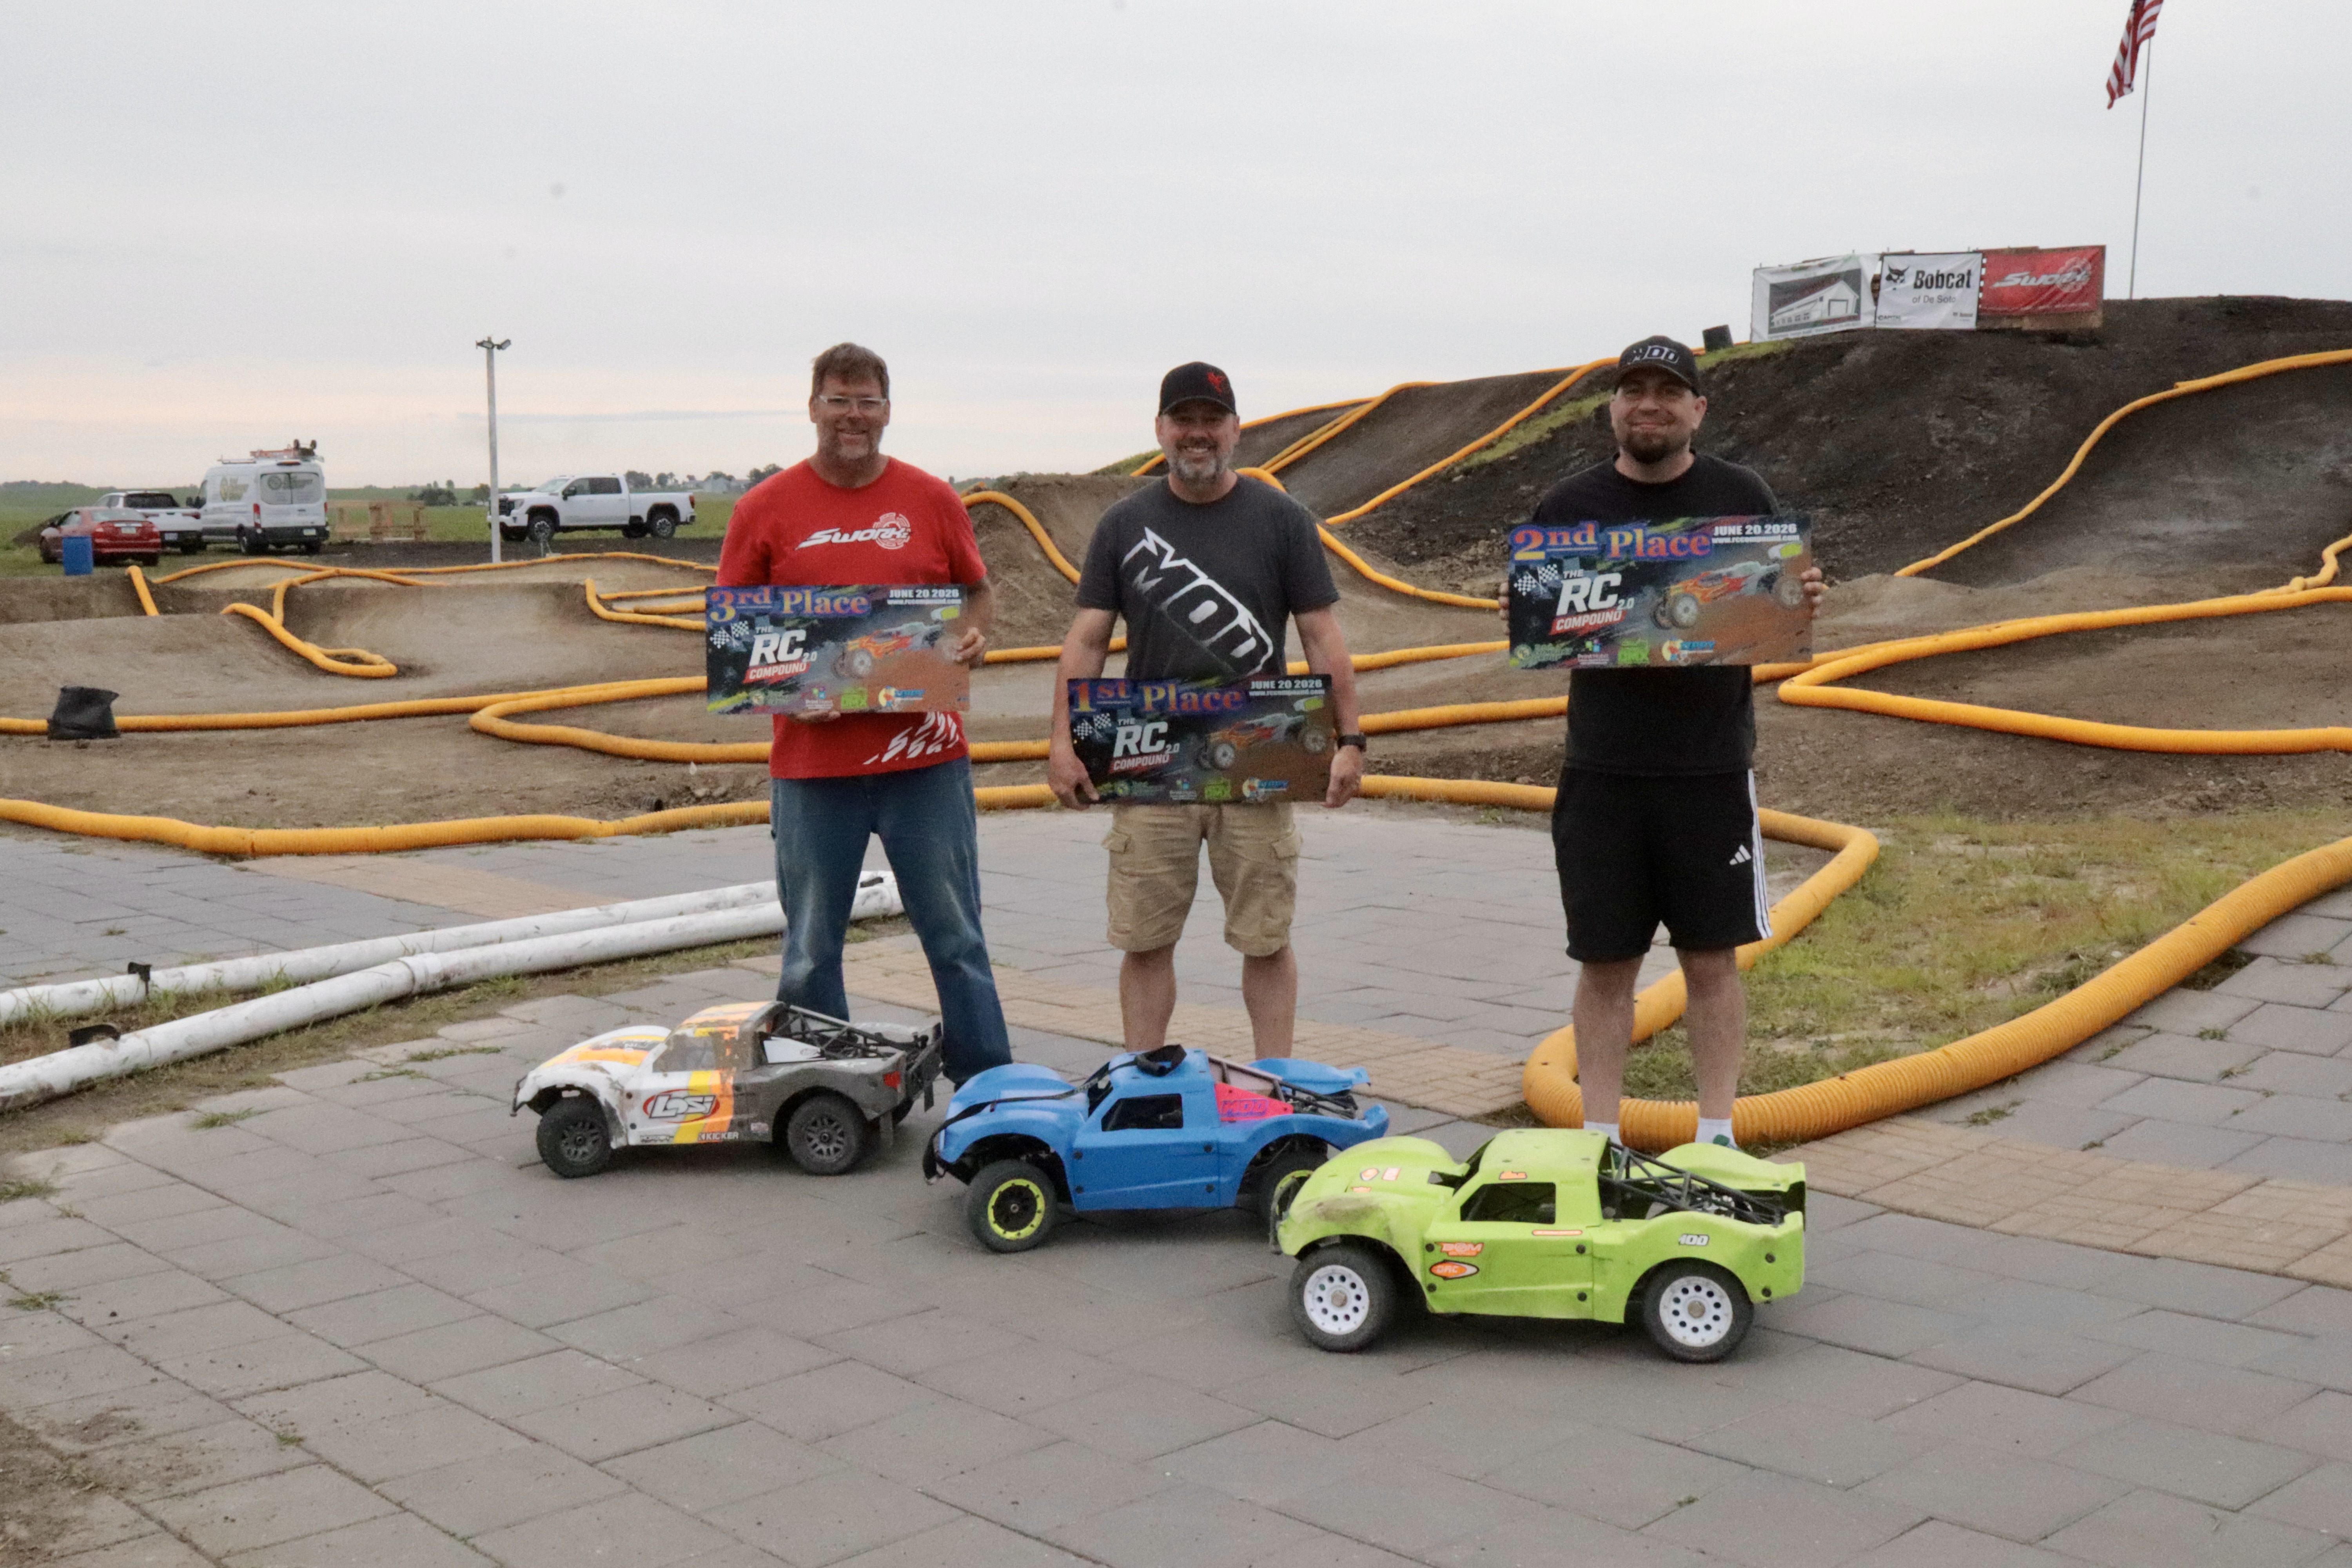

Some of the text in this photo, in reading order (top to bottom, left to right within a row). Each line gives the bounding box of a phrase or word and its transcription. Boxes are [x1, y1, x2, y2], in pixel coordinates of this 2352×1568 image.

[1913, 269, 1972, 289] Bobcat
[1937, 295, 1956, 303] Soto
[1714, 523, 1797, 535] JUNE 20 2026
[1514, 523, 1710, 561] 2nd Place
[1563, 569, 1584, 579] THE
[889, 588, 960, 598] JUNE 20 2026
[1556, 572, 1635, 616] RC 2.0
[710, 588, 869, 622] 3rd Place
[1556, 610, 1622, 630] COMPOUND
[749, 629, 817, 666] RC 2.0
[749, 662, 807, 679] COMPOUND
[1251, 679, 1322, 689] JUNE 20 2026
[1072, 681, 1242, 712] 1st Place
[1118, 718, 1135, 726] THE
[1113, 721, 1180, 758] RC 2.0
[1114, 753, 1170, 771] COMPOUND
[705, 1132, 739, 1140] KICKER
